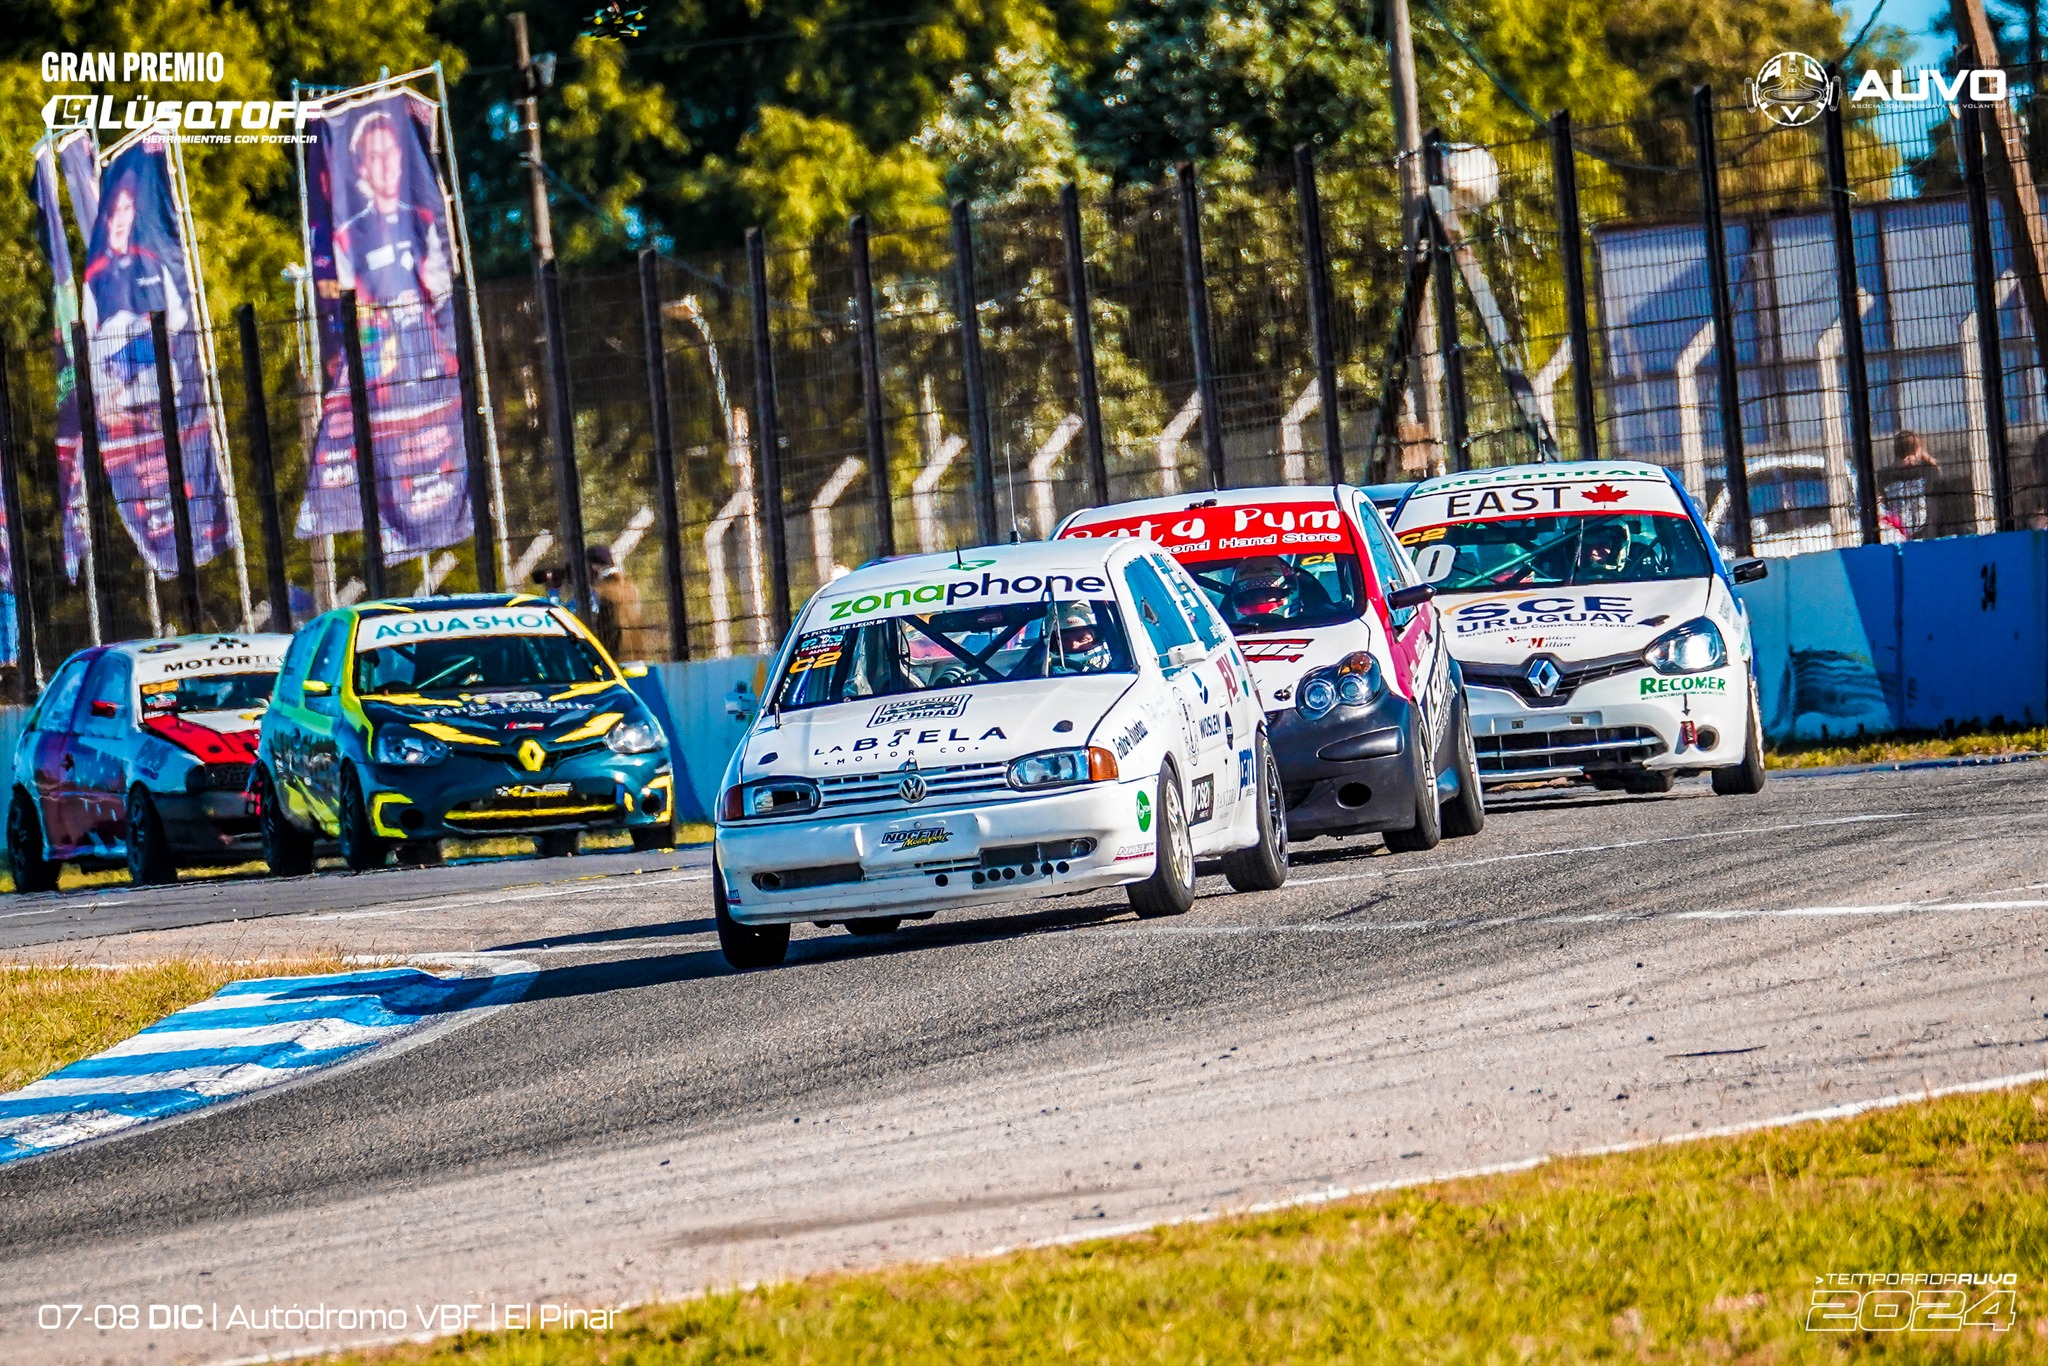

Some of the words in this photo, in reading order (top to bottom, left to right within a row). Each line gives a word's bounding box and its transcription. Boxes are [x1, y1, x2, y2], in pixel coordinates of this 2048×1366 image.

[1447, 486, 1571, 519] EAST
[1234, 509, 1341, 532] Pum
[1218, 534, 1277, 549] Hand
[1281, 532, 1341, 544] Store
[1400, 527, 1447, 545] C2
[829, 573, 1105, 622] zonaphone
[1457, 596, 1633, 621] SCE
[1456, 612, 1633, 634] URUGUAY
[1457, 627, 1510, 638] Servicios
[789, 651, 842, 674] C2
[1640, 676, 1726, 696] RECOMER
[814, 745, 843, 756] LA
[836, 749, 915, 765] MOTOR
[940, 746, 966, 754] CO
